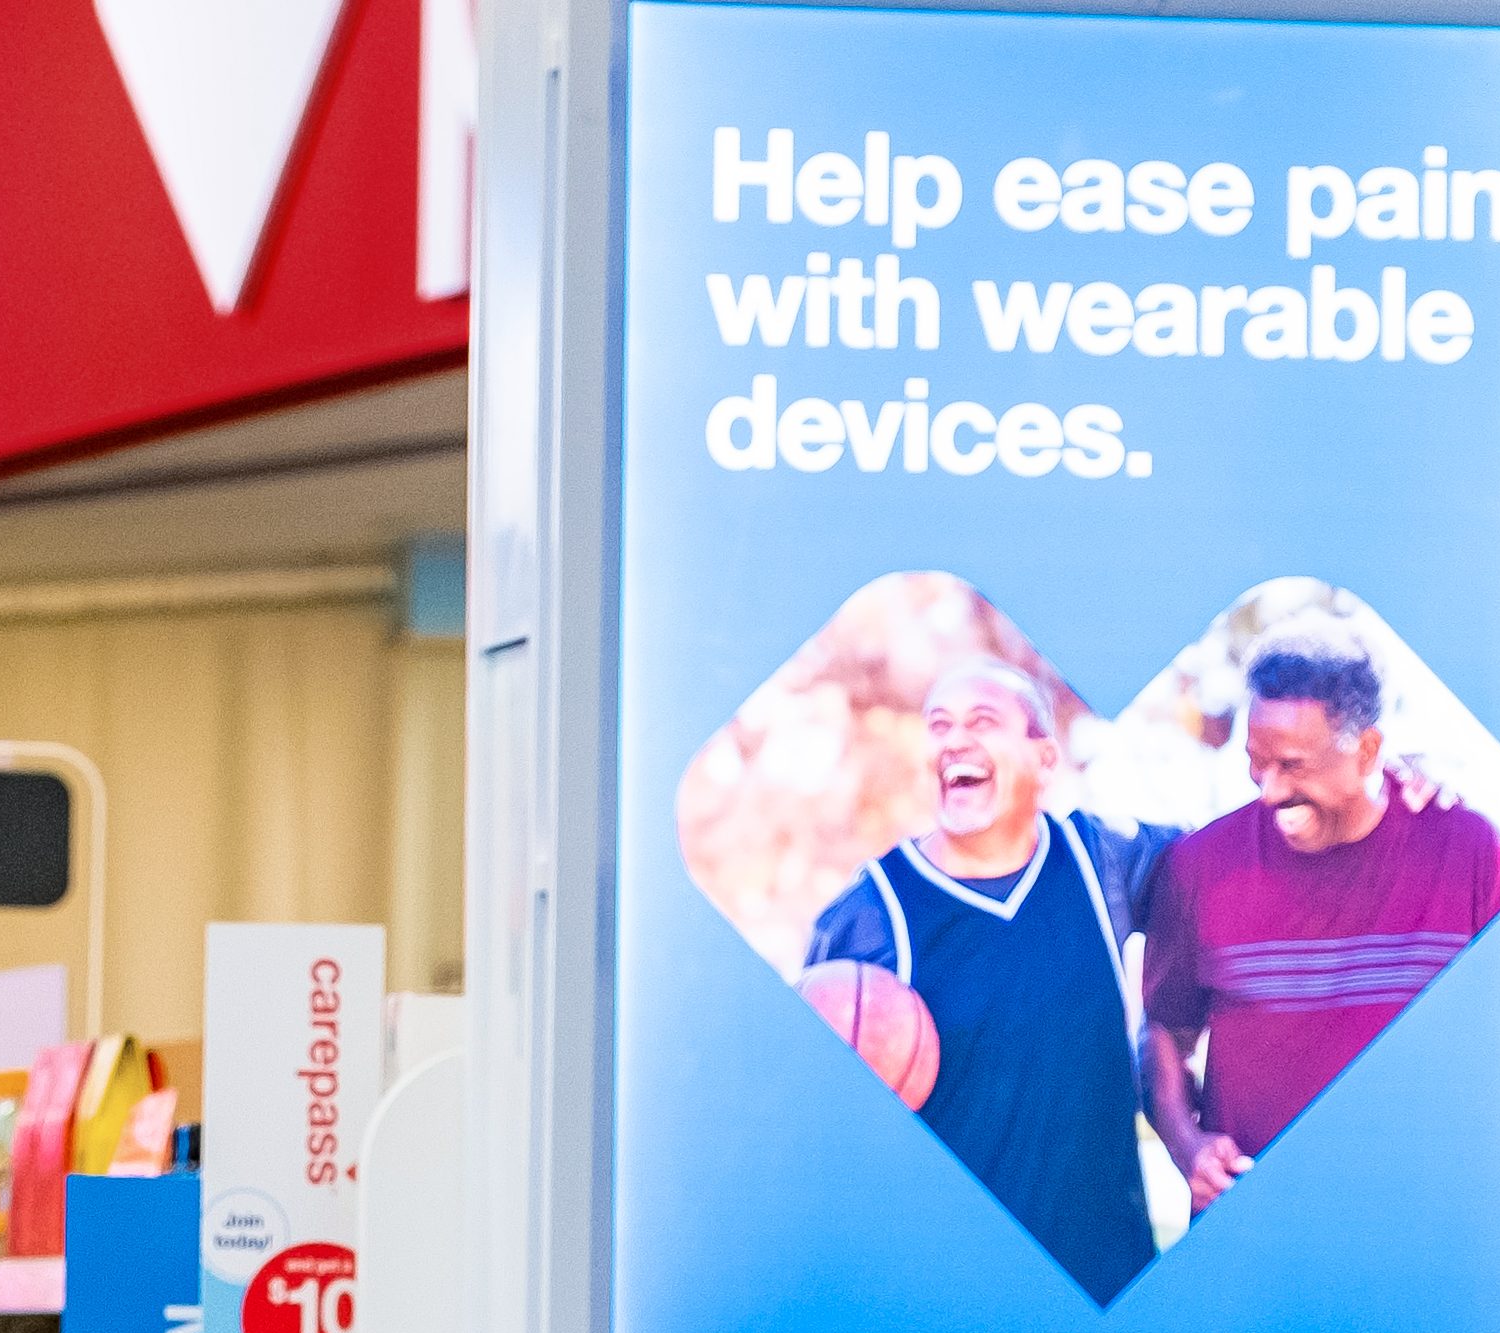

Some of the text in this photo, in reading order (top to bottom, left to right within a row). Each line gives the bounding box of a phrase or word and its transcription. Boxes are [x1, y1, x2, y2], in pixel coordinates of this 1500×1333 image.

[712, 126, 963, 249] Help
[993, 155, 1255, 236] ease
[705, 252, 1475, 365] with wearable
[705, 374, 1152, 480] devices.
[297, 957, 341, 1187] carepass
